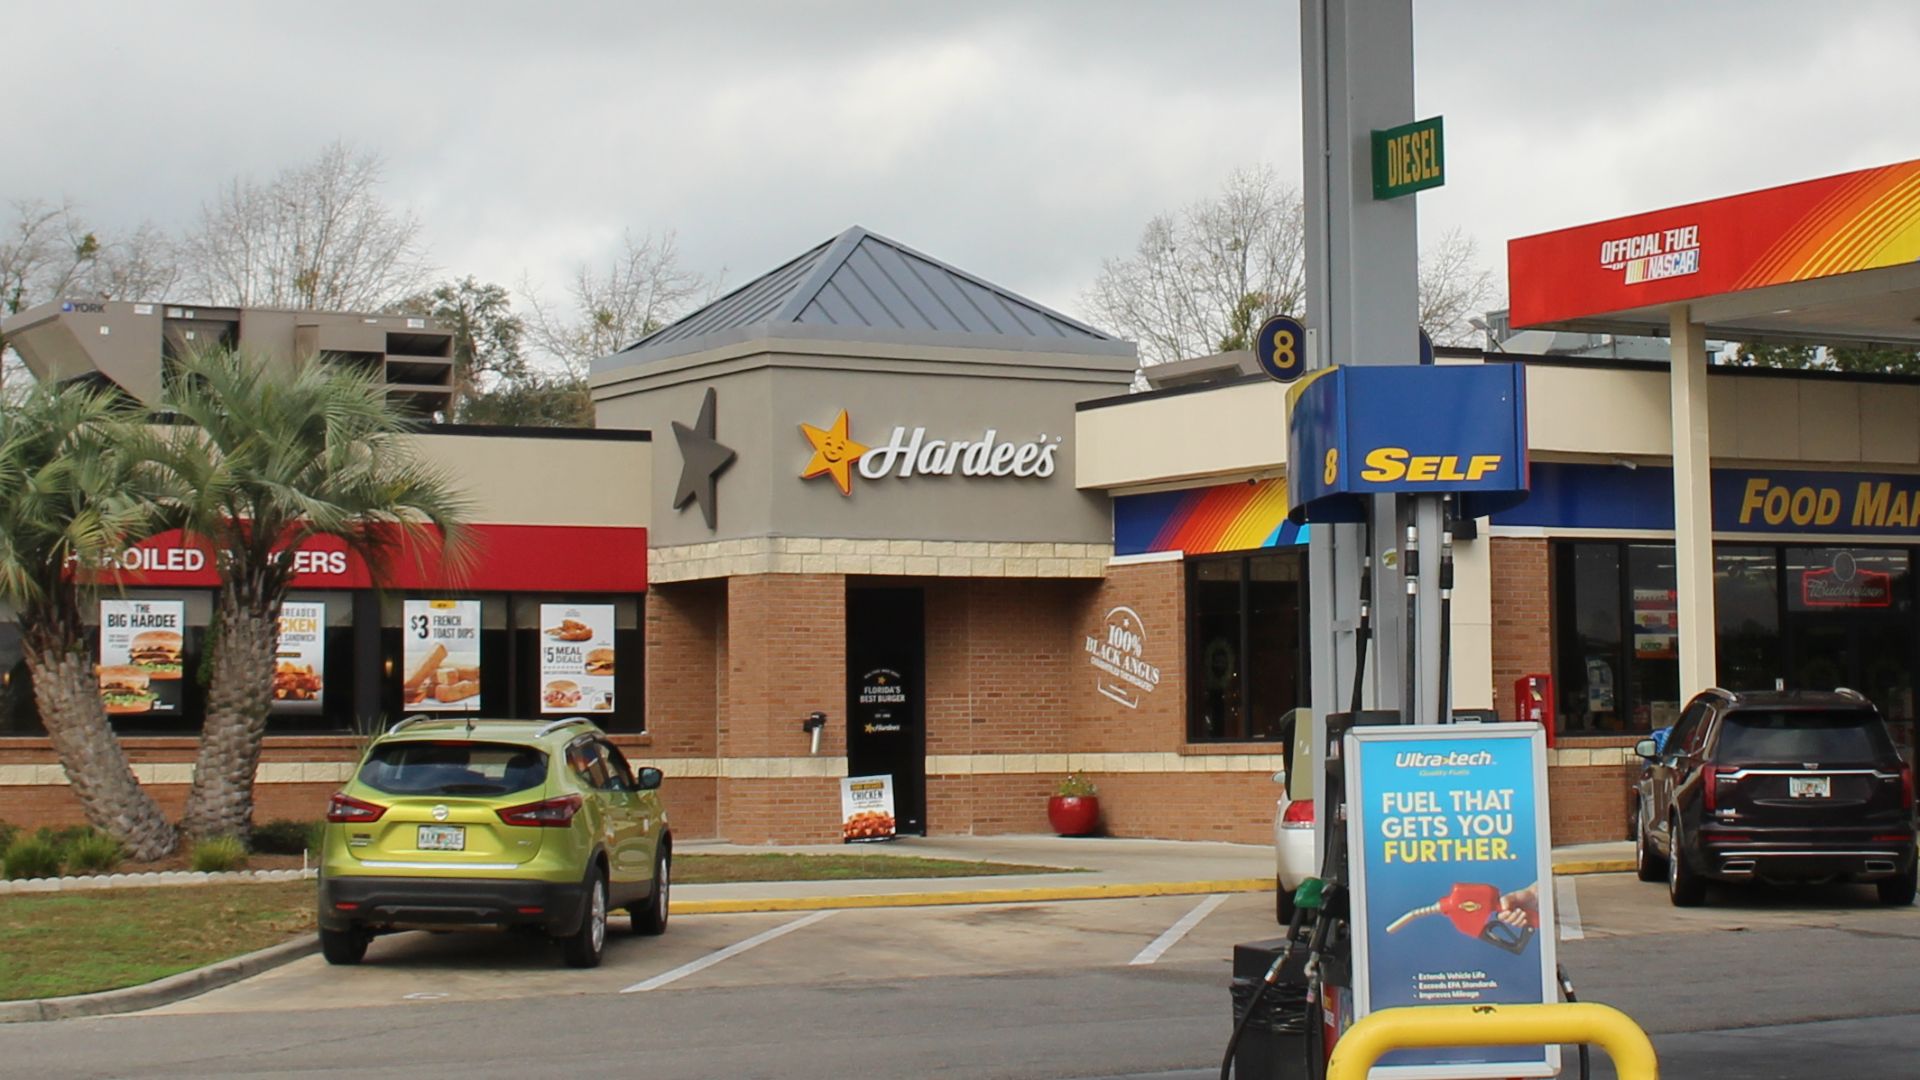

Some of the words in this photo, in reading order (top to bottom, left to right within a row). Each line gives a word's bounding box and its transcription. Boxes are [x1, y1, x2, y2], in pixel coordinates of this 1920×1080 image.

[1387, 127, 1440, 188] DIESEL
[1601, 231, 1662, 265] OFFICIAL
[1663, 225, 1701, 253] FUEL
[1647, 248, 1700, 279] NASCAR
[74, 302, 106, 313] YORK
[1272, 329, 1296, 369] 8
[857, 426, 1059, 480] Hardee's
[1322, 447, 1338, 486] 8
[1738, 478, 1841, 526] FOOD
[107, 614, 128, 628] BIG
[130, 614, 177, 628] HARDEE
[134, 604, 151, 613] THE
[433, 615, 462, 627] FRENCH
[411, 614, 429, 639] $3
[433, 627, 456, 639] TOAST
[457, 627, 476, 639] DIPS
[555, 646, 582, 655] MEAL
[1107, 624, 1143, 658] 100%
[555, 656, 583, 664] DEALS
[1084, 635, 1122, 667] BLACK
[1121, 654, 1160, 685] ANGUS
[859, 694, 877, 703] BEST
[851, 789, 884, 801] CHICKEN
[1381, 791, 1443, 814] FUEL
[1449, 789, 1515, 812] THAT
[1381, 816, 1449, 839] GETS
[1456, 814, 1514, 837] YOU
[1383, 838, 1518, 864] FURTHER.
[1418, 972, 1446, 981] Extends
[1446, 971, 1472, 980] Vehicle
[1472, 970, 1486, 979] Life
[1418, 982, 1447, 990] Exceeds
[1462, 979, 1498, 989] Standards
[1418, 991, 1452, 1000] Improves
[1452, 990, 1480, 999] Mileage
